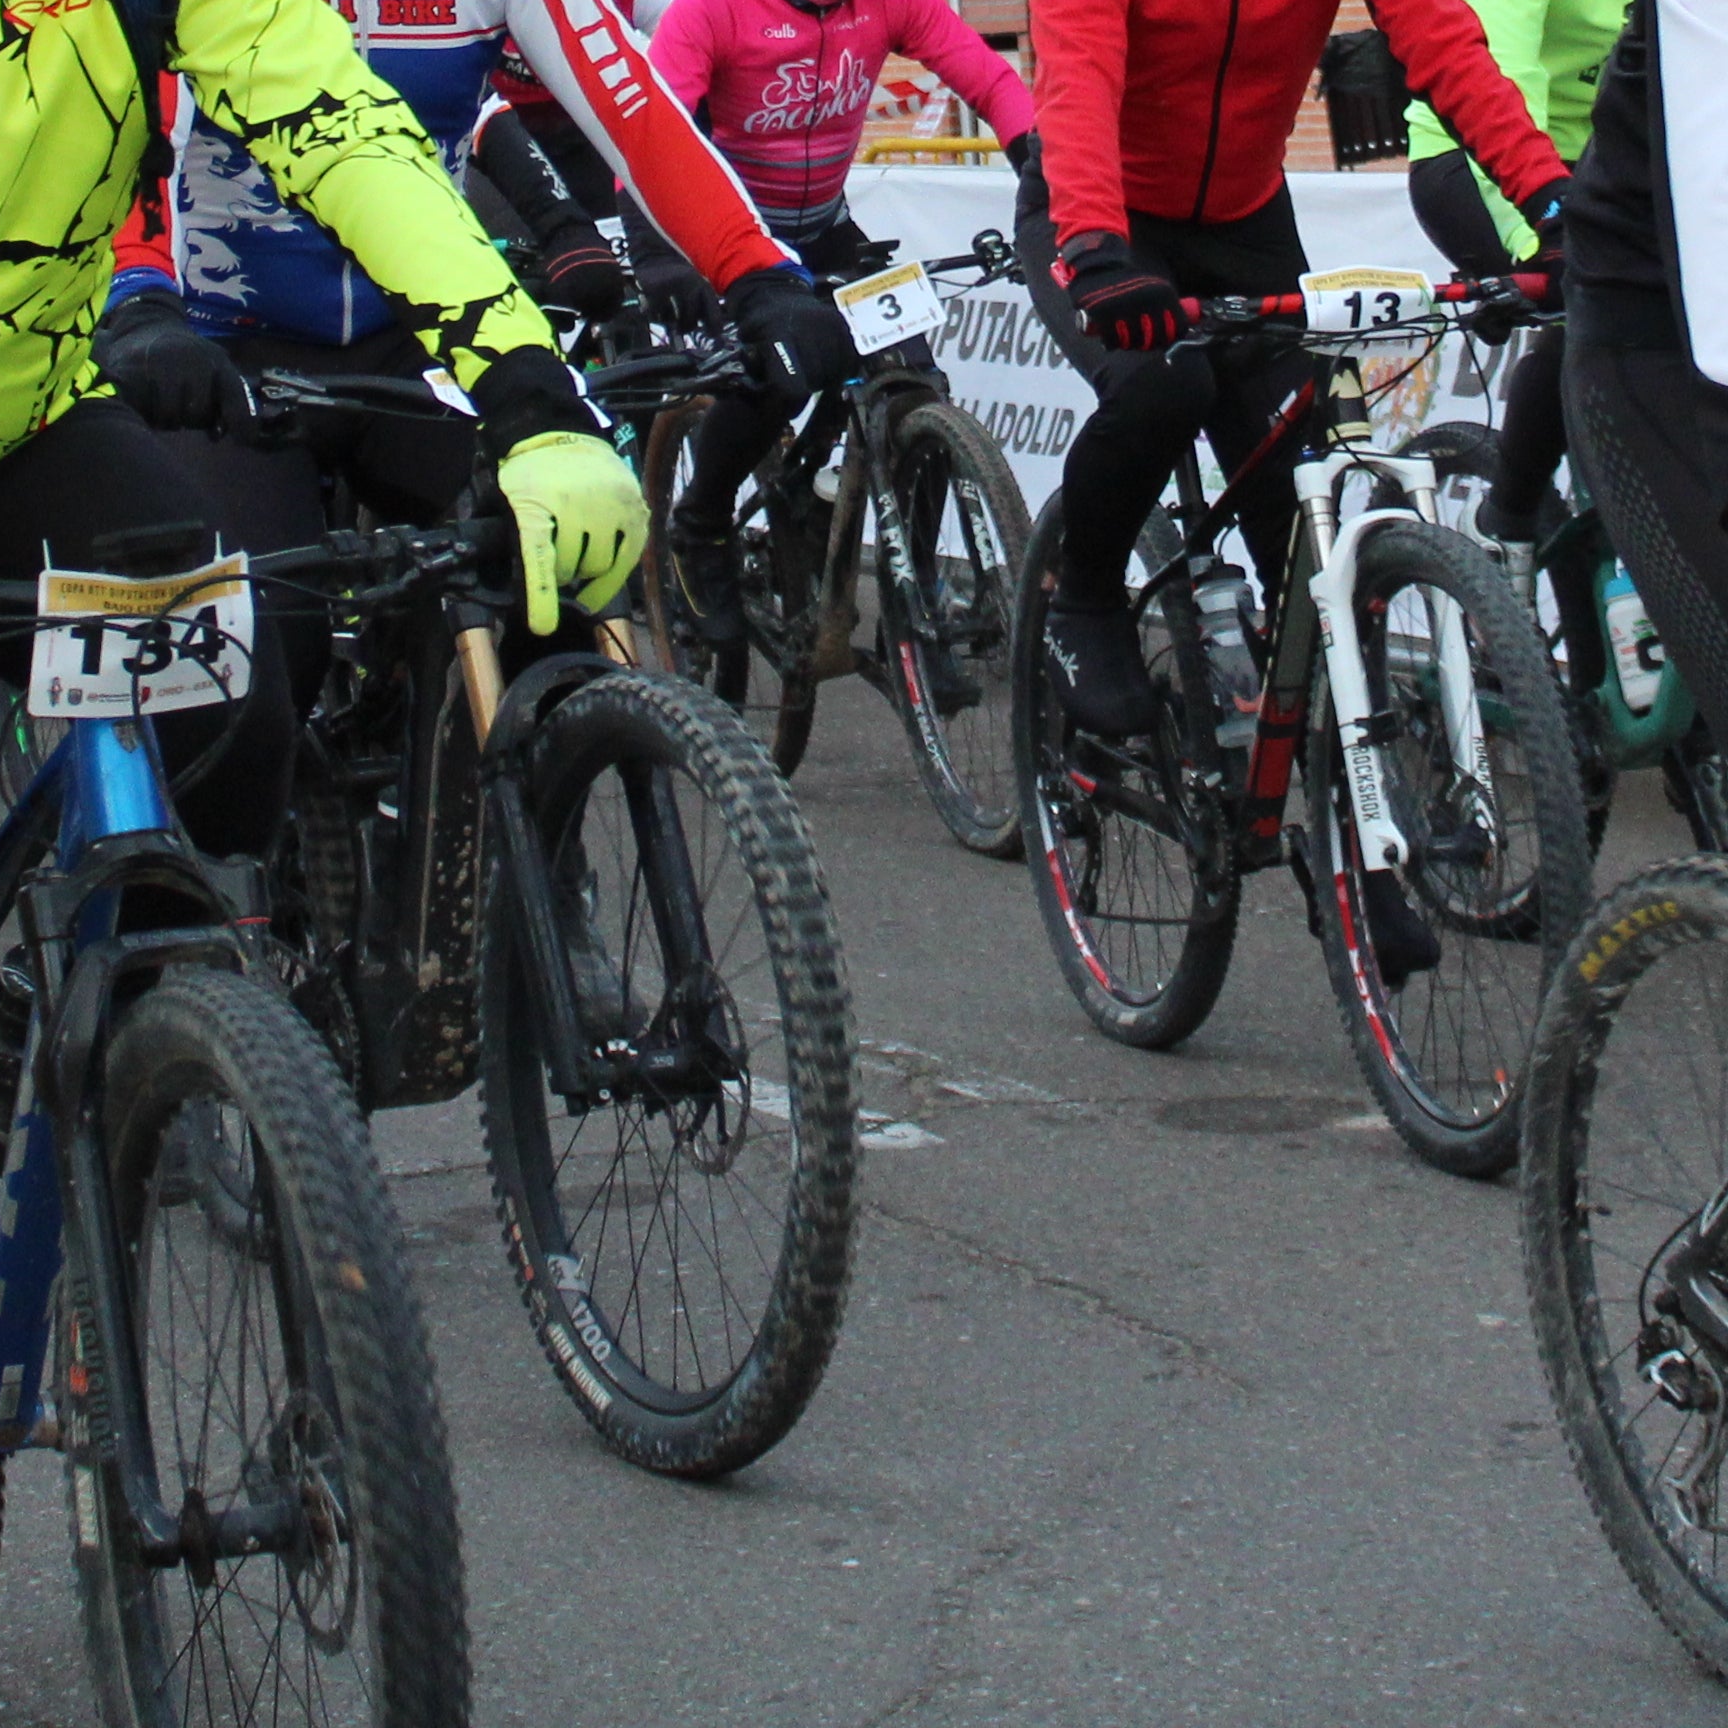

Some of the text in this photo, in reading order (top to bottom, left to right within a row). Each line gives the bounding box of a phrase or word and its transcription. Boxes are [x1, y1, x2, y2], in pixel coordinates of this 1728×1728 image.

[876, 293, 904, 321] 3
[1343, 290, 1401, 329] 13
[70, 604, 226, 676] 134
[571, 1300, 613, 1360] 1700
